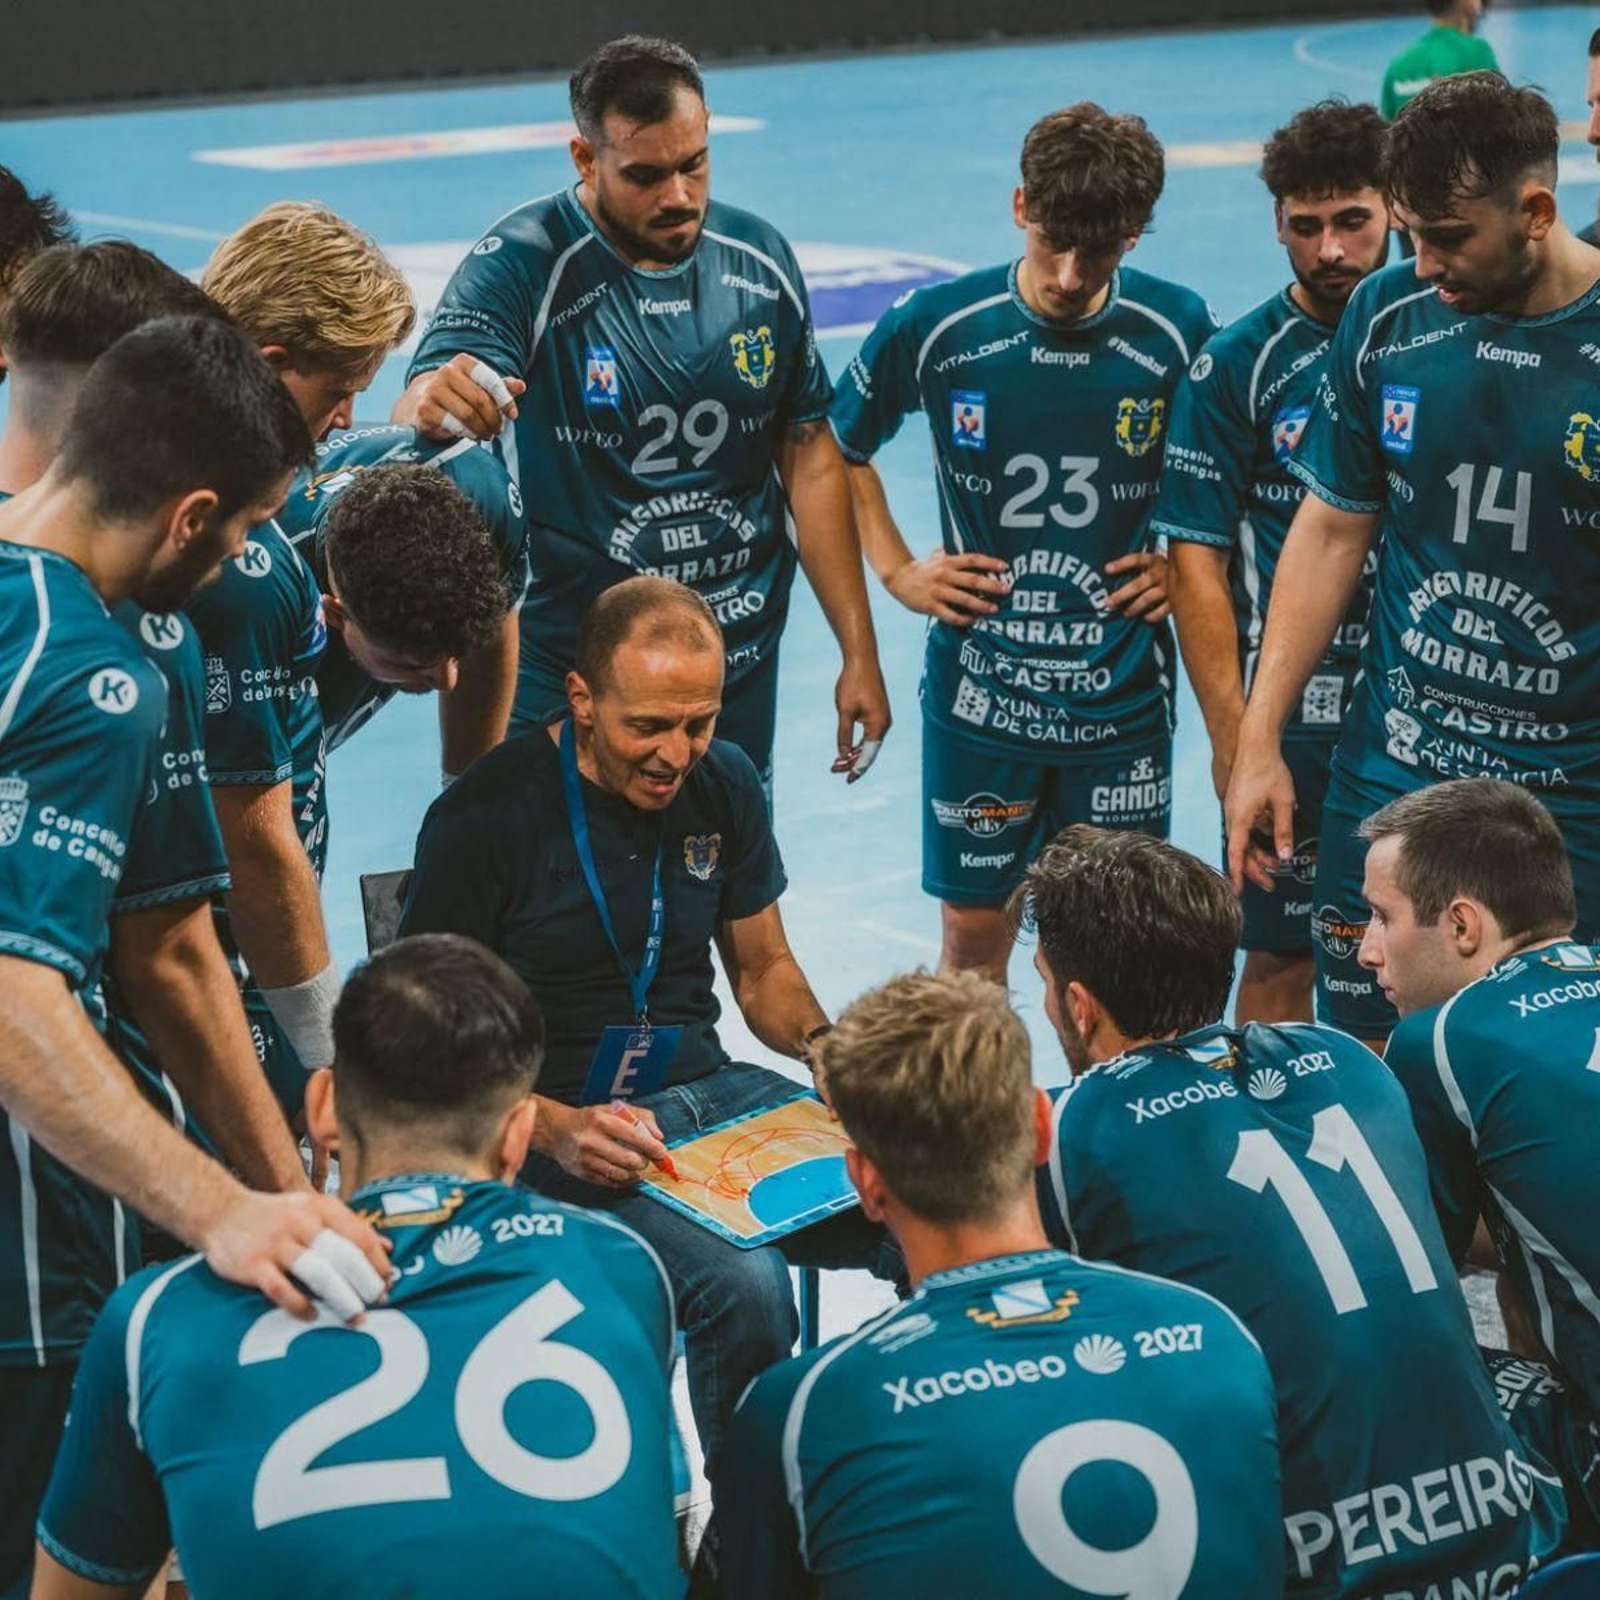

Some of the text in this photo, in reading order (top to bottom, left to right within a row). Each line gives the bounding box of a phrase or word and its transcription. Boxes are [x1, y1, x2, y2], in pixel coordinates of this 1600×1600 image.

[638, 297, 691, 317] Kempa
[933, 331, 1030, 374] VITALDENT
[1030, 346, 1091, 371] Kempa
[1363, 322, 1468, 364] VITALDENT
[1475, 340, 1542, 369] Kempa
[1258, 339, 1330, 407] VITALDENT
[315, 425, 408, 458] Xacobe
[631, 400, 730, 475] 29
[1164, 442, 1214, 465] oncello
[1173, 458, 1221, 481] Cangas
[999, 453, 1100, 529] 23
[1252, 481, 1304, 501] WOFC
[1446, 462, 1533, 552] 14
[660, 525, 708, 552] DEL
[1011, 590, 1060, 613] DEL
[1452, 607, 1504, 646] DEL
[995, 660, 1111, 693] CASTRO
[1400, 627, 1560, 696] MORRAZO
[995, 695, 1070, 723] XUNTA
[1419, 700, 1569, 742] CASTRO
[1423, 685, 1537, 721] CONSTRUCCIONES
[991, 711, 1118, 744] DE GALICIA
[167, 772, 193, 790] de
[39, 805, 126, 857] Concello
[32, 829, 121, 882] de Canga
[960, 853, 1015, 869] Kempa
[1323, 973, 1373, 998] Kempa
[1508, 979, 1600, 1019] Xacobe
[609, 1048, 648, 1096] E
[1125, 1050, 1337, 1125] Xacobe 2027
[1225, 1102, 1440, 1315] 11
[490, 1213, 565, 1244] 2027
[882, 1323, 1204, 1414] Xacobeo 2027
[238, 1278, 633, 1531] 26
[1012, 1418, 1199, 1600] 9
[1283, 1449, 1535, 1580] PEREIRO
